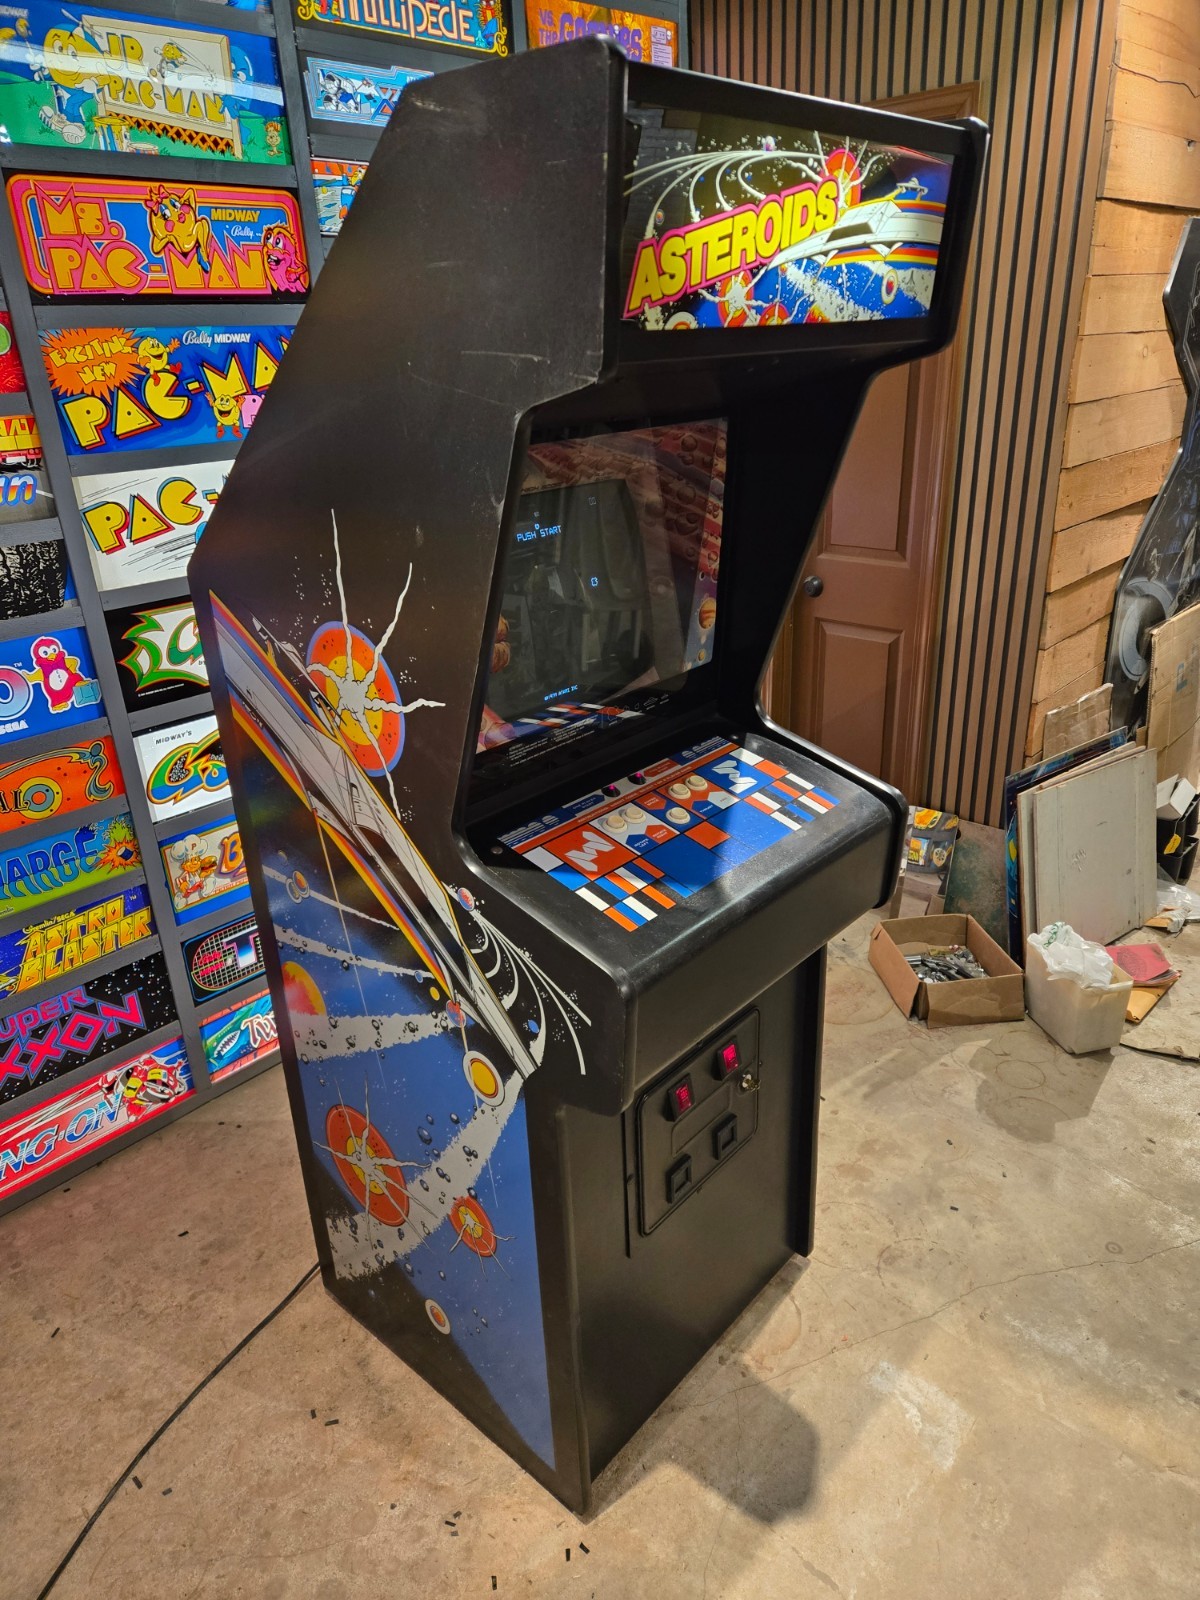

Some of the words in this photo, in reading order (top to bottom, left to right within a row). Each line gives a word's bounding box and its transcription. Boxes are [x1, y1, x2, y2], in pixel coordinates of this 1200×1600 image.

[107, 74, 226, 123] PAC-MAN
[210, 208, 260, 222] MIDWAY
[230, 224, 254, 240] Bally
[625, 178, 839, 315] ASTEROIDS
[46, 240, 270, 291] PAC-MAN
[48, 335, 133, 368] EXCITING
[182, 329, 212, 348] Bally
[213, 333, 251, 343] MIDWAY
[77, 360, 118, 386] NEW
[58, 335, 291, 450] PAC-MA
[516, 531, 537, 542] PUSH
[540, 525, 562, 538] START
[155, 730, 193, 745] MIDWAY'S
[14, 894, 125, 963] ASTRO
[7, 905, 152, 998] BLASTER
